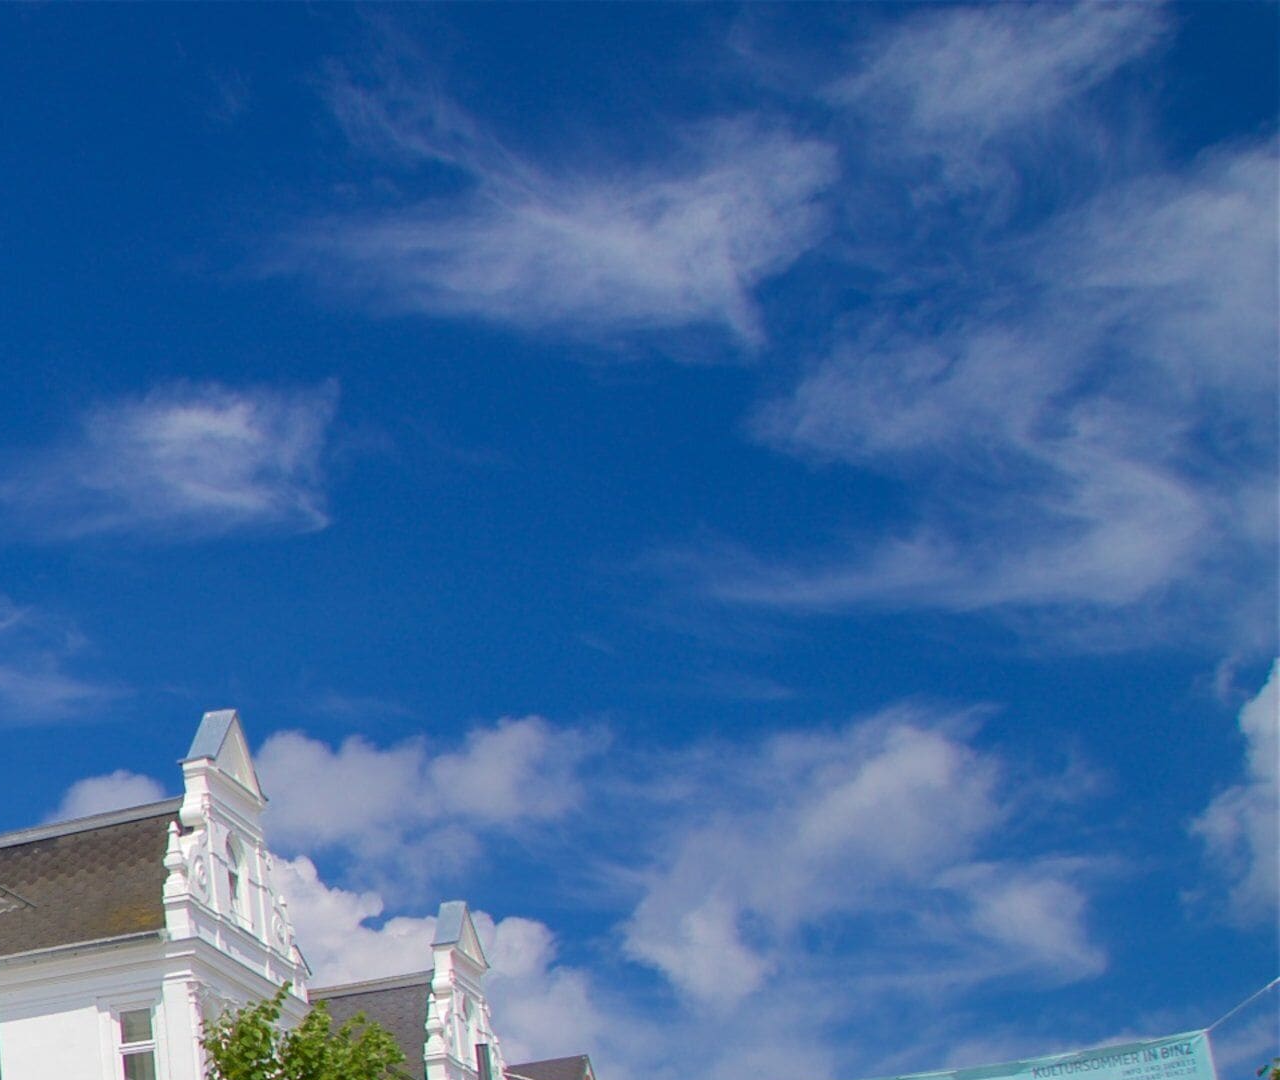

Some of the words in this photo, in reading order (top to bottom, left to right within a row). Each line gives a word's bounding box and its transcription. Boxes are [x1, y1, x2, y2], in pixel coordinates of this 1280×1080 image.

[1032, 1052, 1140, 1080] KULTURSOMMER
[1144, 1047, 1159, 1063] IN
[1161, 1043, 1194, 1060] BINZ
